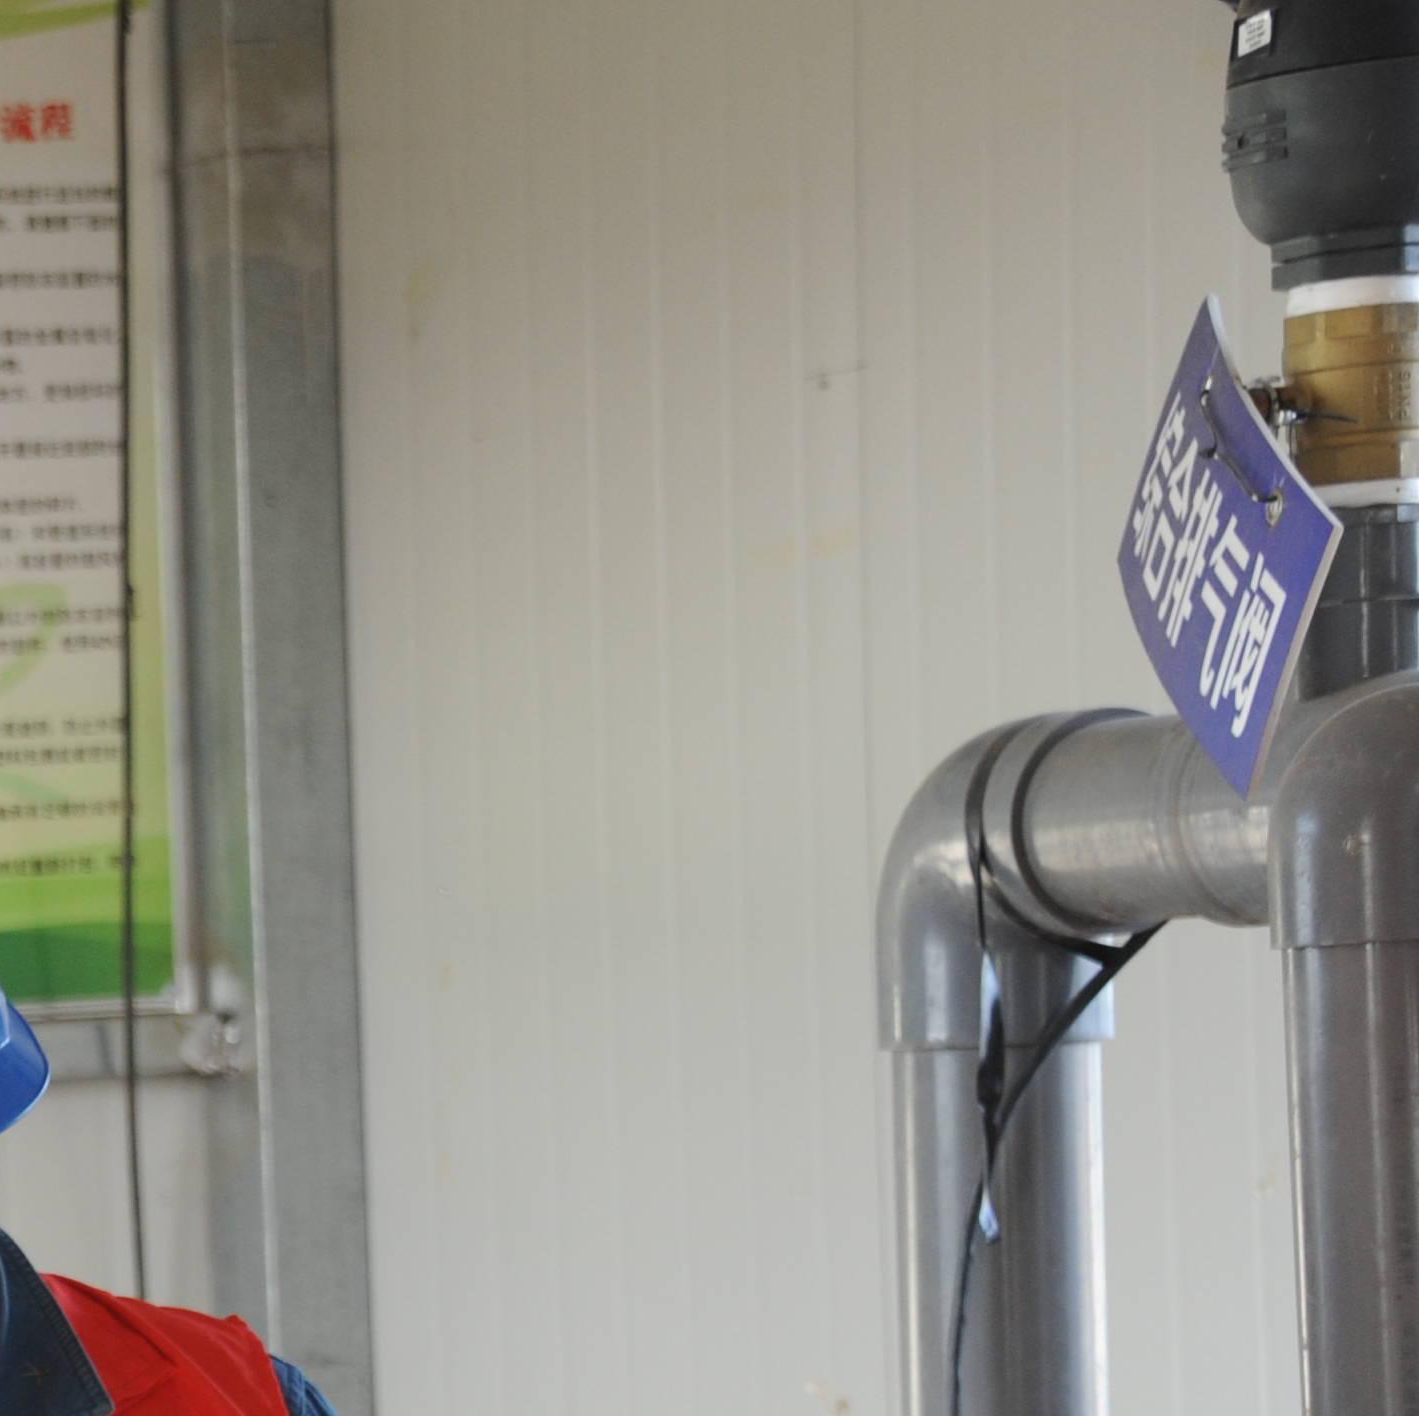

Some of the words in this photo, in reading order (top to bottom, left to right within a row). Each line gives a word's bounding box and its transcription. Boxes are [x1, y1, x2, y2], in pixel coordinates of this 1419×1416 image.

[1133, 391, 1287, 738] 综合排气阀
